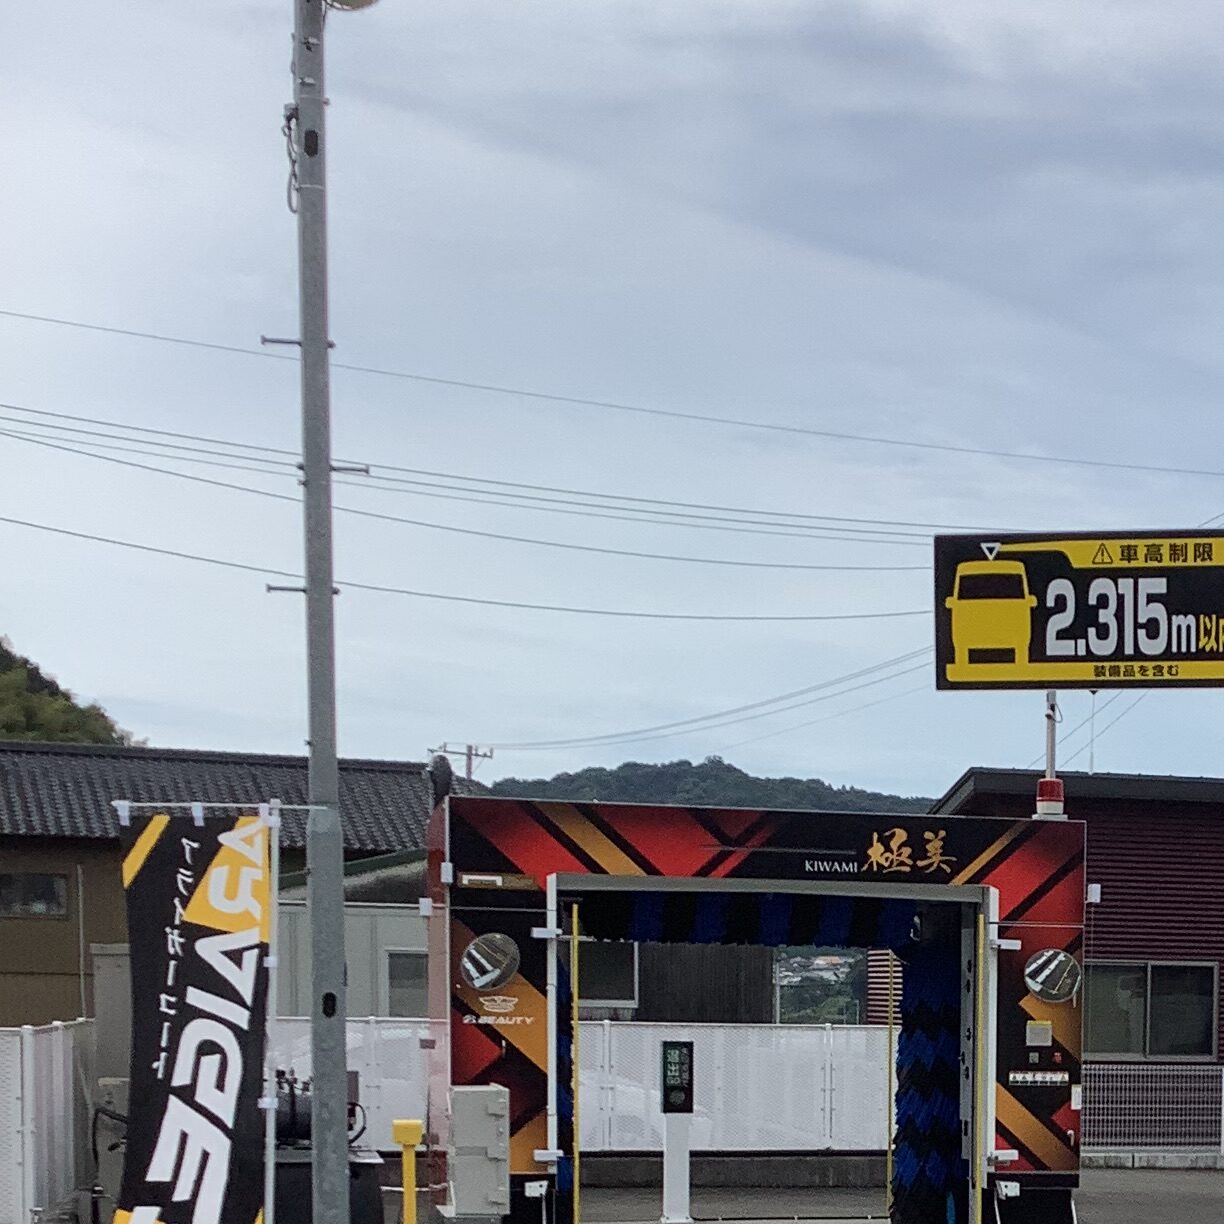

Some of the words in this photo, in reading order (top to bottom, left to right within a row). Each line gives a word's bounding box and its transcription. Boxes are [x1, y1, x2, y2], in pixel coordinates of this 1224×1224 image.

[1119, 543, 1214, 563] 車高制限
[1093, 664, 1179, 678] 装備品を含む
[805, 860, 858, 873] KIWAMI
[861, 828, 957, 873] 極美
